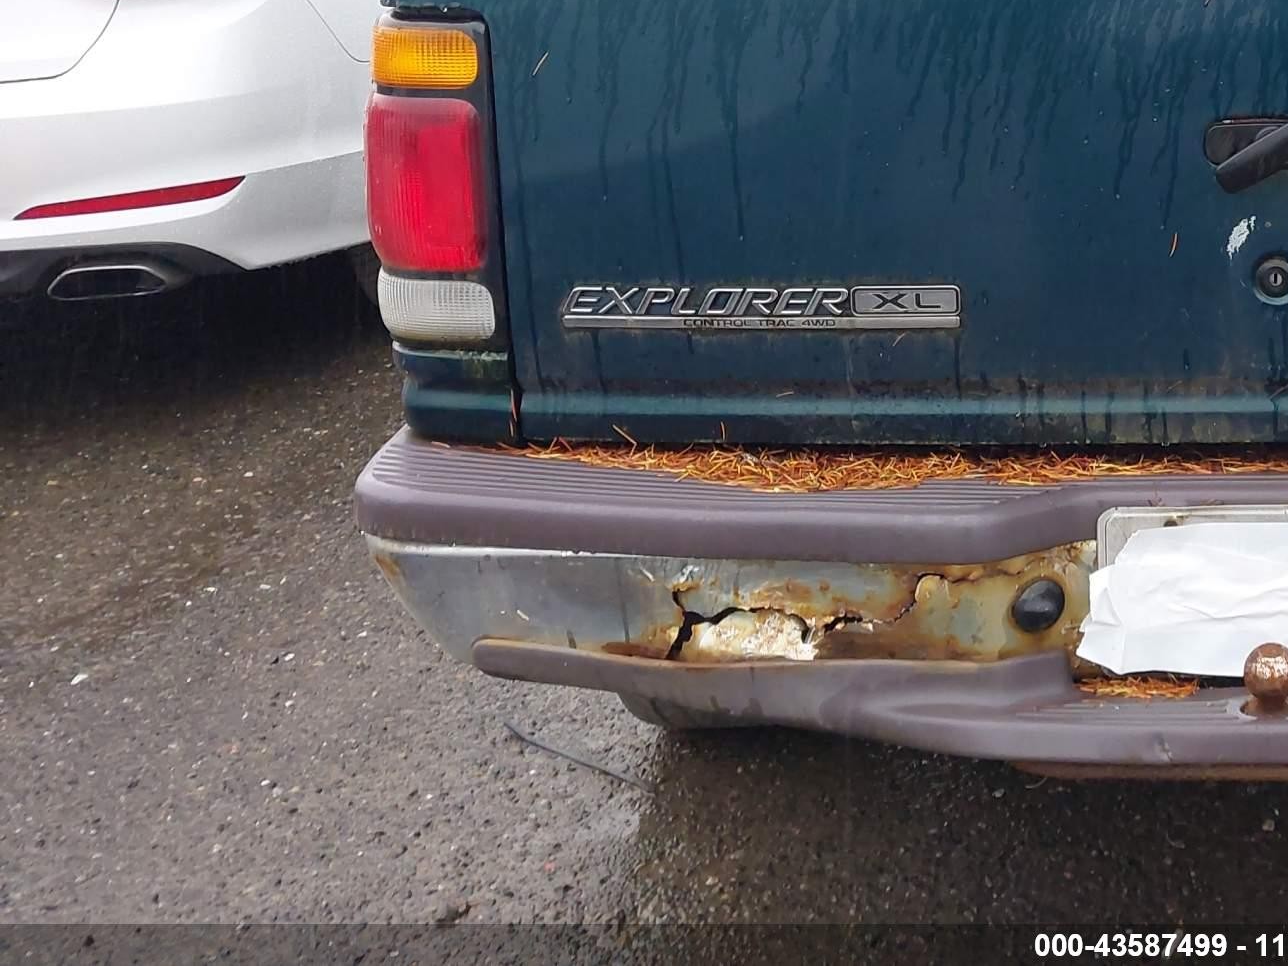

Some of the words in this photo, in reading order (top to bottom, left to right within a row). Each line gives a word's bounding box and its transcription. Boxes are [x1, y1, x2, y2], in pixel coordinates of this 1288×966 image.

[564, 286, 850, 316] EXPLORER
[870, 291, 942, 310] XL
[683, 318, 750, 327] CONTROL
[758, 318, 795, 327] TRAC
[801, 318, 836, 327] 4WD
